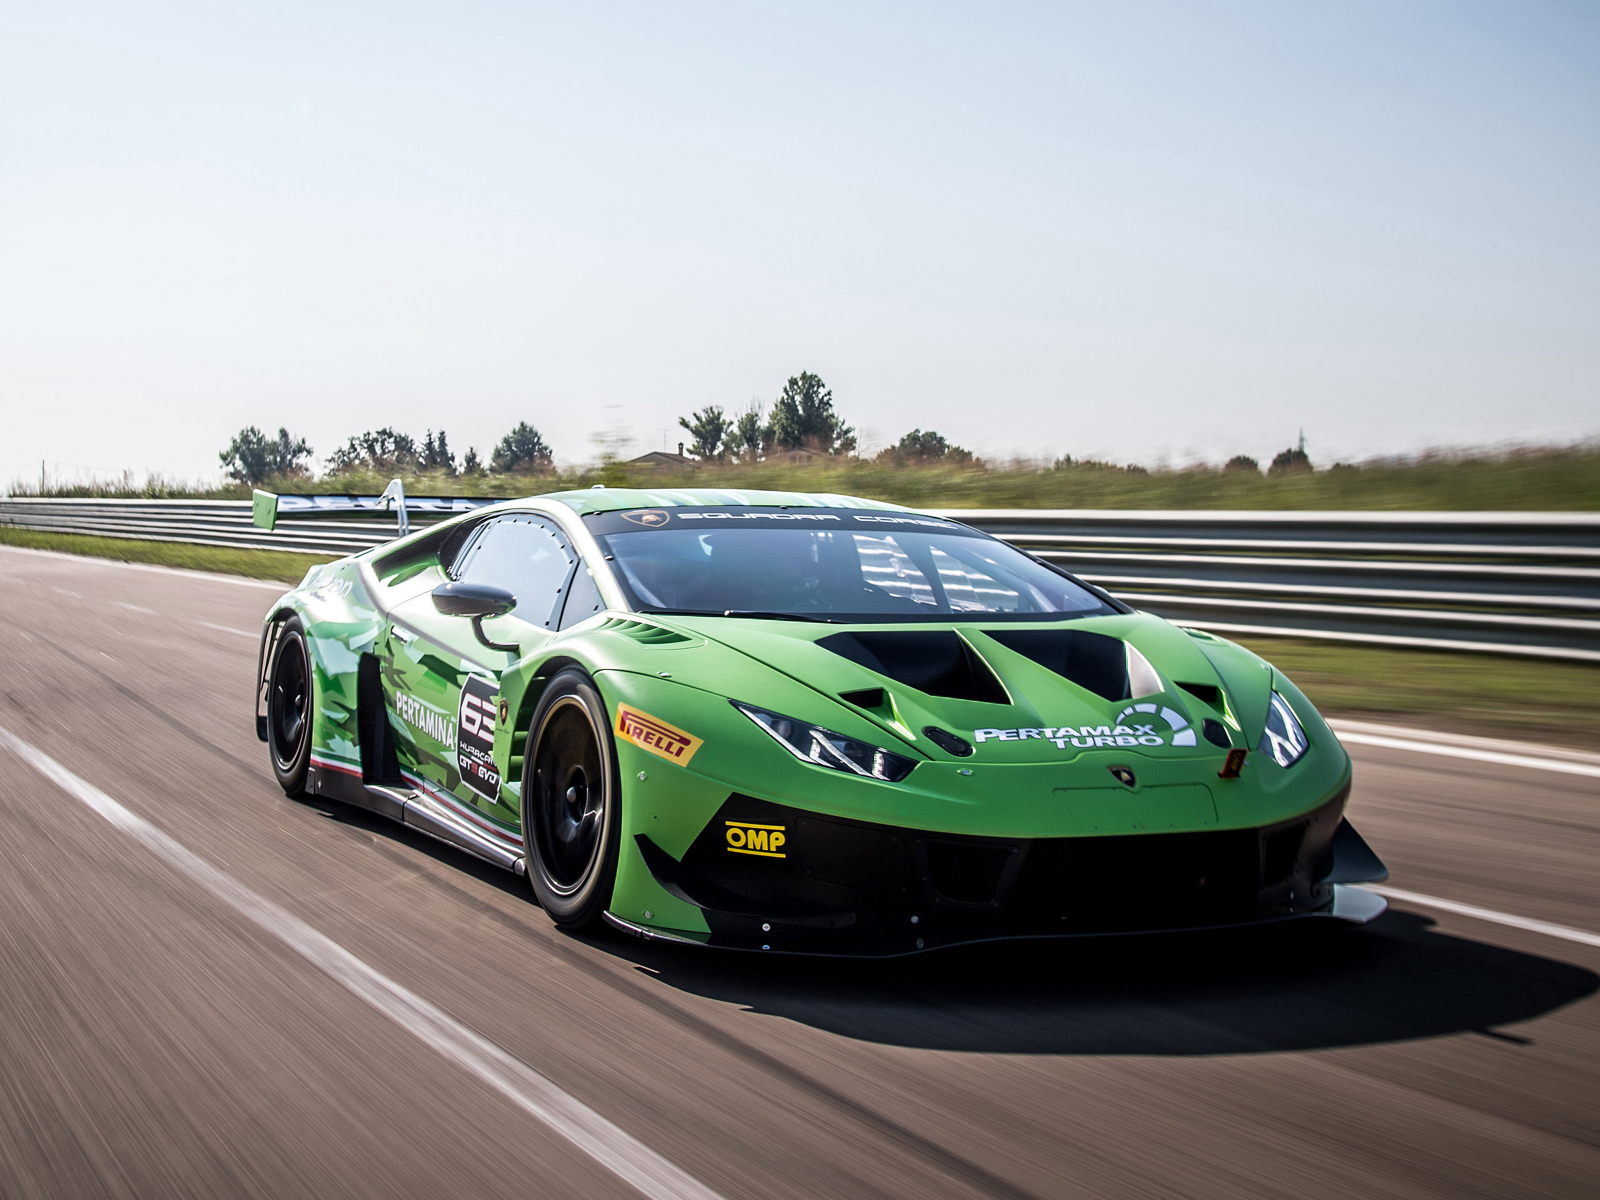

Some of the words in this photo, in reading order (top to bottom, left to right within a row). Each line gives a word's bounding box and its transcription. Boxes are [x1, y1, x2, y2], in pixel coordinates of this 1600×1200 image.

[677, 512, 841, 521] SQUADRA
[853, 515, 958, 529] CORSE
[396, 690, 454, 750] PERTAMINA
[461, 692, 497, 743] 63
[619, 710, 692, 757] PIRELLI
[974, 724, 1157, 743] PERTAMAX
[1049, 735, 1165, 749] TURBO
[460, 754, 478, 775] GT3
[478, 768, 497, 785] EVO
[726, 827, 786, 852] OMP
